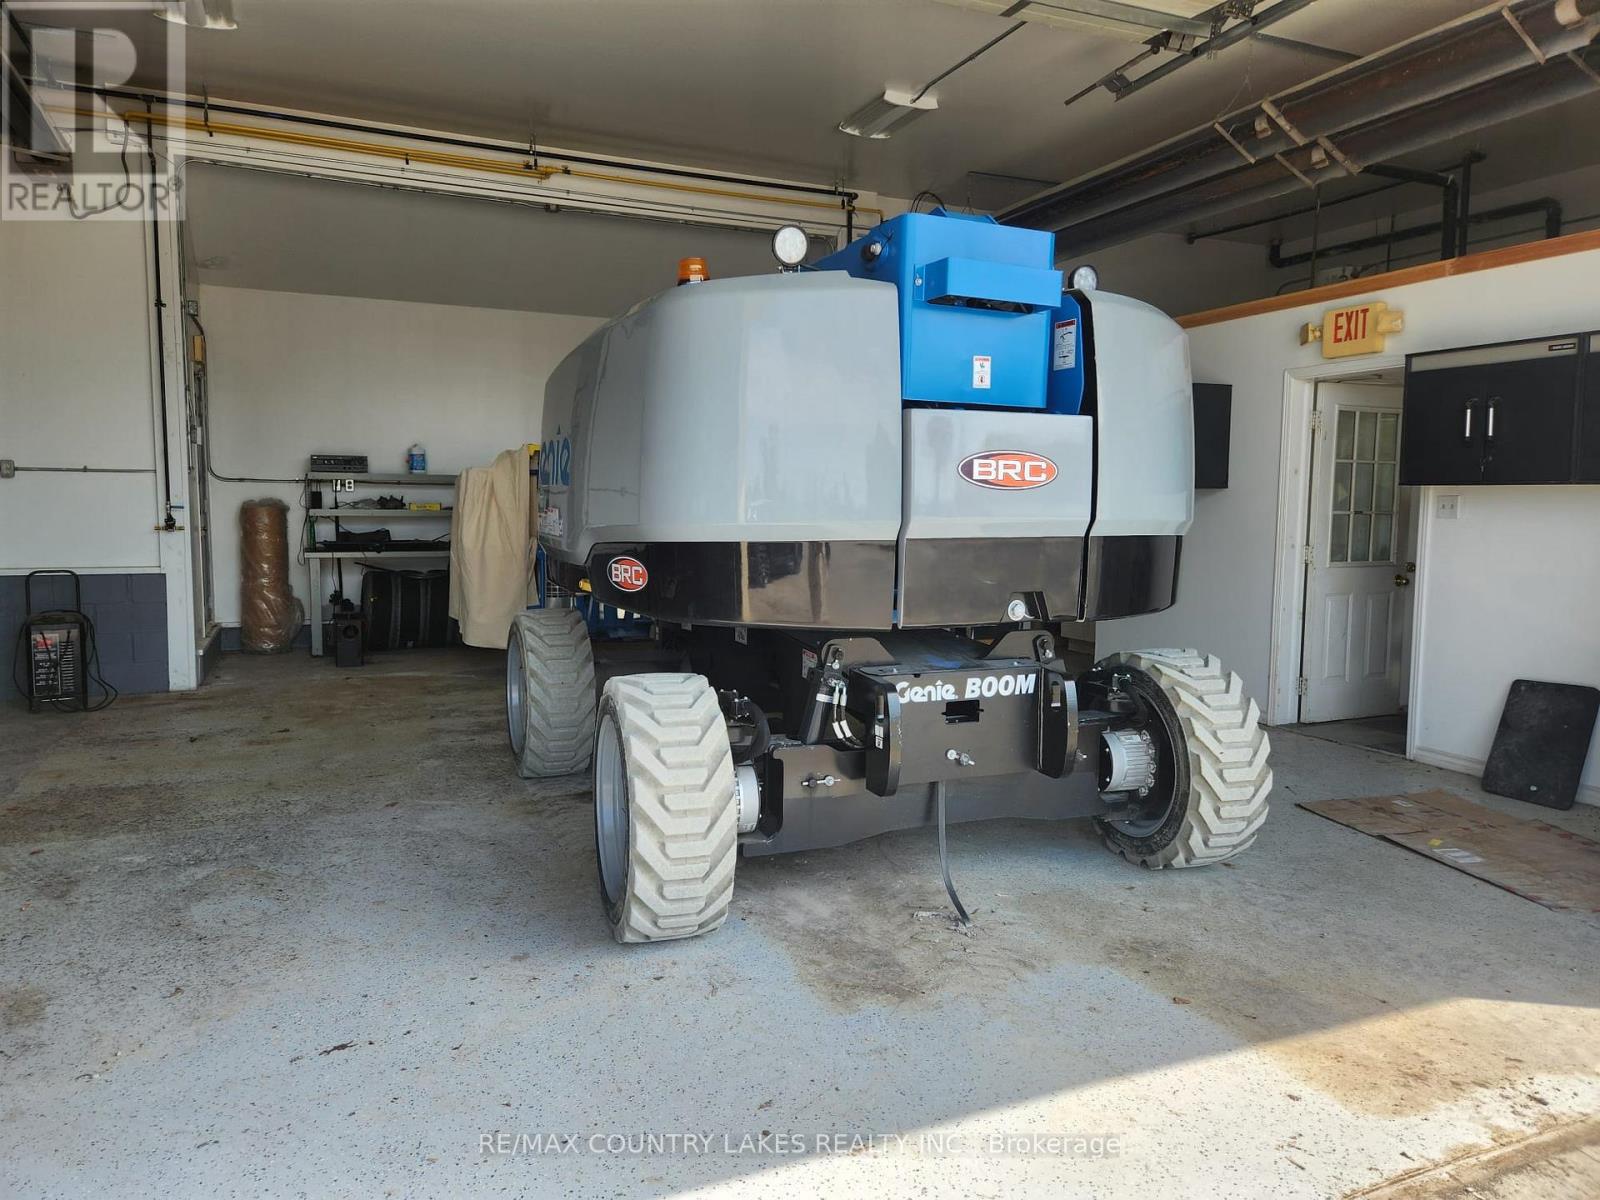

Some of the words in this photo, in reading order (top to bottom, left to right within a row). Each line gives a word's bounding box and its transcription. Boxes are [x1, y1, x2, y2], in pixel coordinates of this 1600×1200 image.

[1333, 307, 1370, 344] EXIT
[972, 458, 1047, 482] BRC
[611, 563, 643, 586] BRC
[895, 680, 956, 704] Genie
[964, 673, 1037, 699] BOOM
